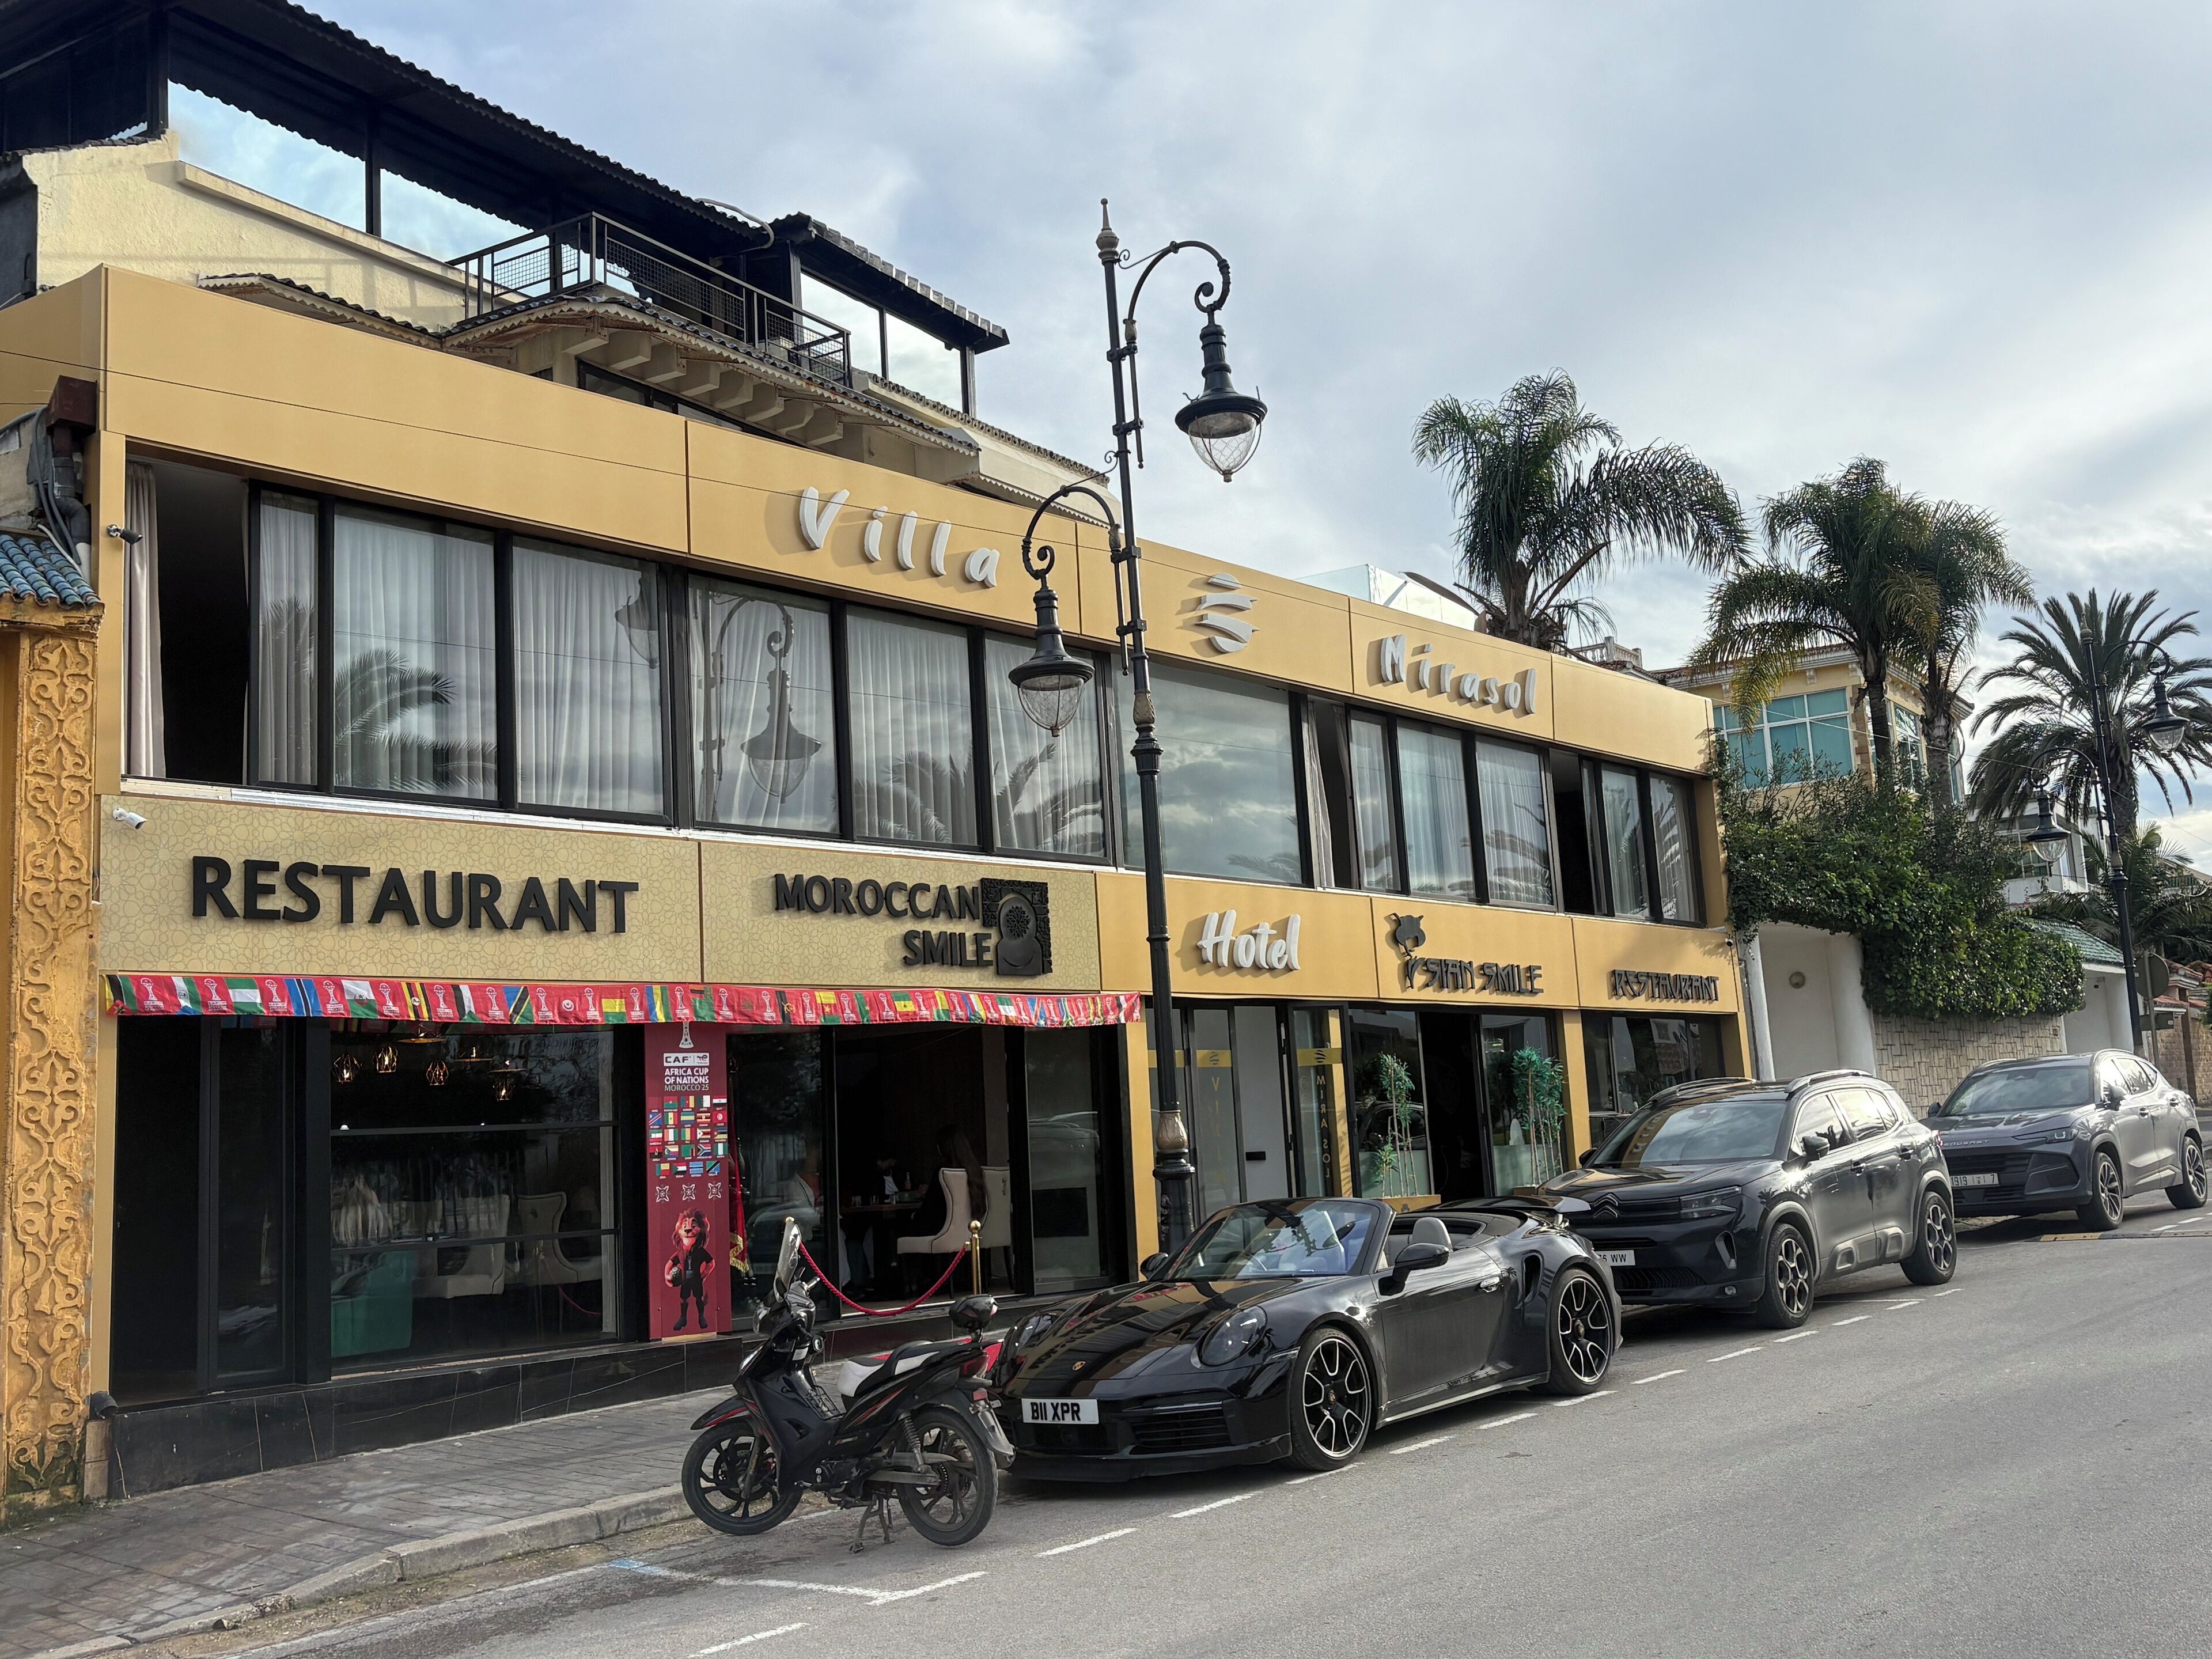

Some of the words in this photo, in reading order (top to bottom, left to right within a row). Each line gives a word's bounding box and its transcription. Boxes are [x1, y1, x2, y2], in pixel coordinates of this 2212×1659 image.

[800, 487, 999, 588] Villa
[1380, 634, 1536, 714] Mirasol
[192, 856, 639, 933] RESTAURANT
[774, 874, 980, 920] MOROCCAN
[903, 930, 993, 966] SMILE
[1197, 909, 1301, 970] Hotel
[1482, 962, 1544, 993] SMILE
[1612, 969, 1719, 1001] RESTAURANT
[664, 1068, 692, 1076] AFRICA
[694, 1067, 709, 1075] CUP
[664, 1077, 675, 1085] OF
[676, 1076, 709, 1084] NATIONS
[1990, 1174, 1995, 1184] 7
[1611, 1253, 1626, 1263] WW
[1051, 1402, 1081, 1421] XPR
